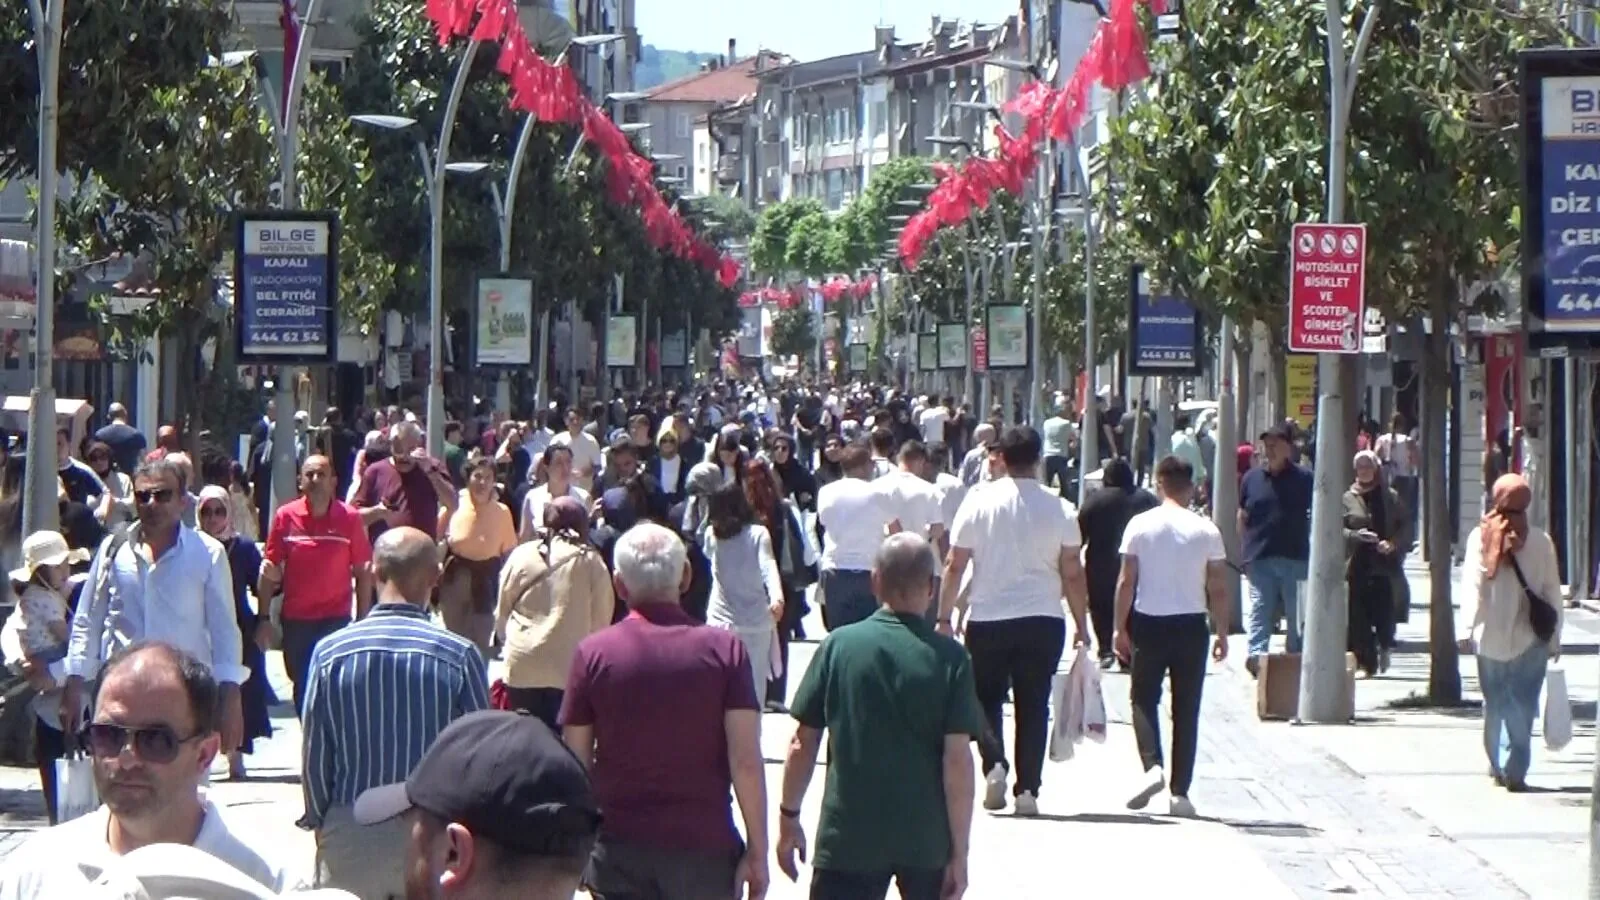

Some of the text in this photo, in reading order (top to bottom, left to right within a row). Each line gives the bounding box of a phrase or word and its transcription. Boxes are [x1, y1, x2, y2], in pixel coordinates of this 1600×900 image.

[1565, 164, 1600, 181] KA
[1550, 192, 1591, 213] DİZ
[260, 229, 316, 241] BILGE
[264, 258, 308, 268] KAPALI
[1296, 260, 1359, 273] MOTOSİKLET
[1304, 274, 1349, 288] BİSİKLET
[256, 291, 279, 300] BEL
[1320, 291, 1333, 301] VE
[256, 305, 316, 316] CERRAHİSİ
[251, 332, 320, 342] 444 62 54
